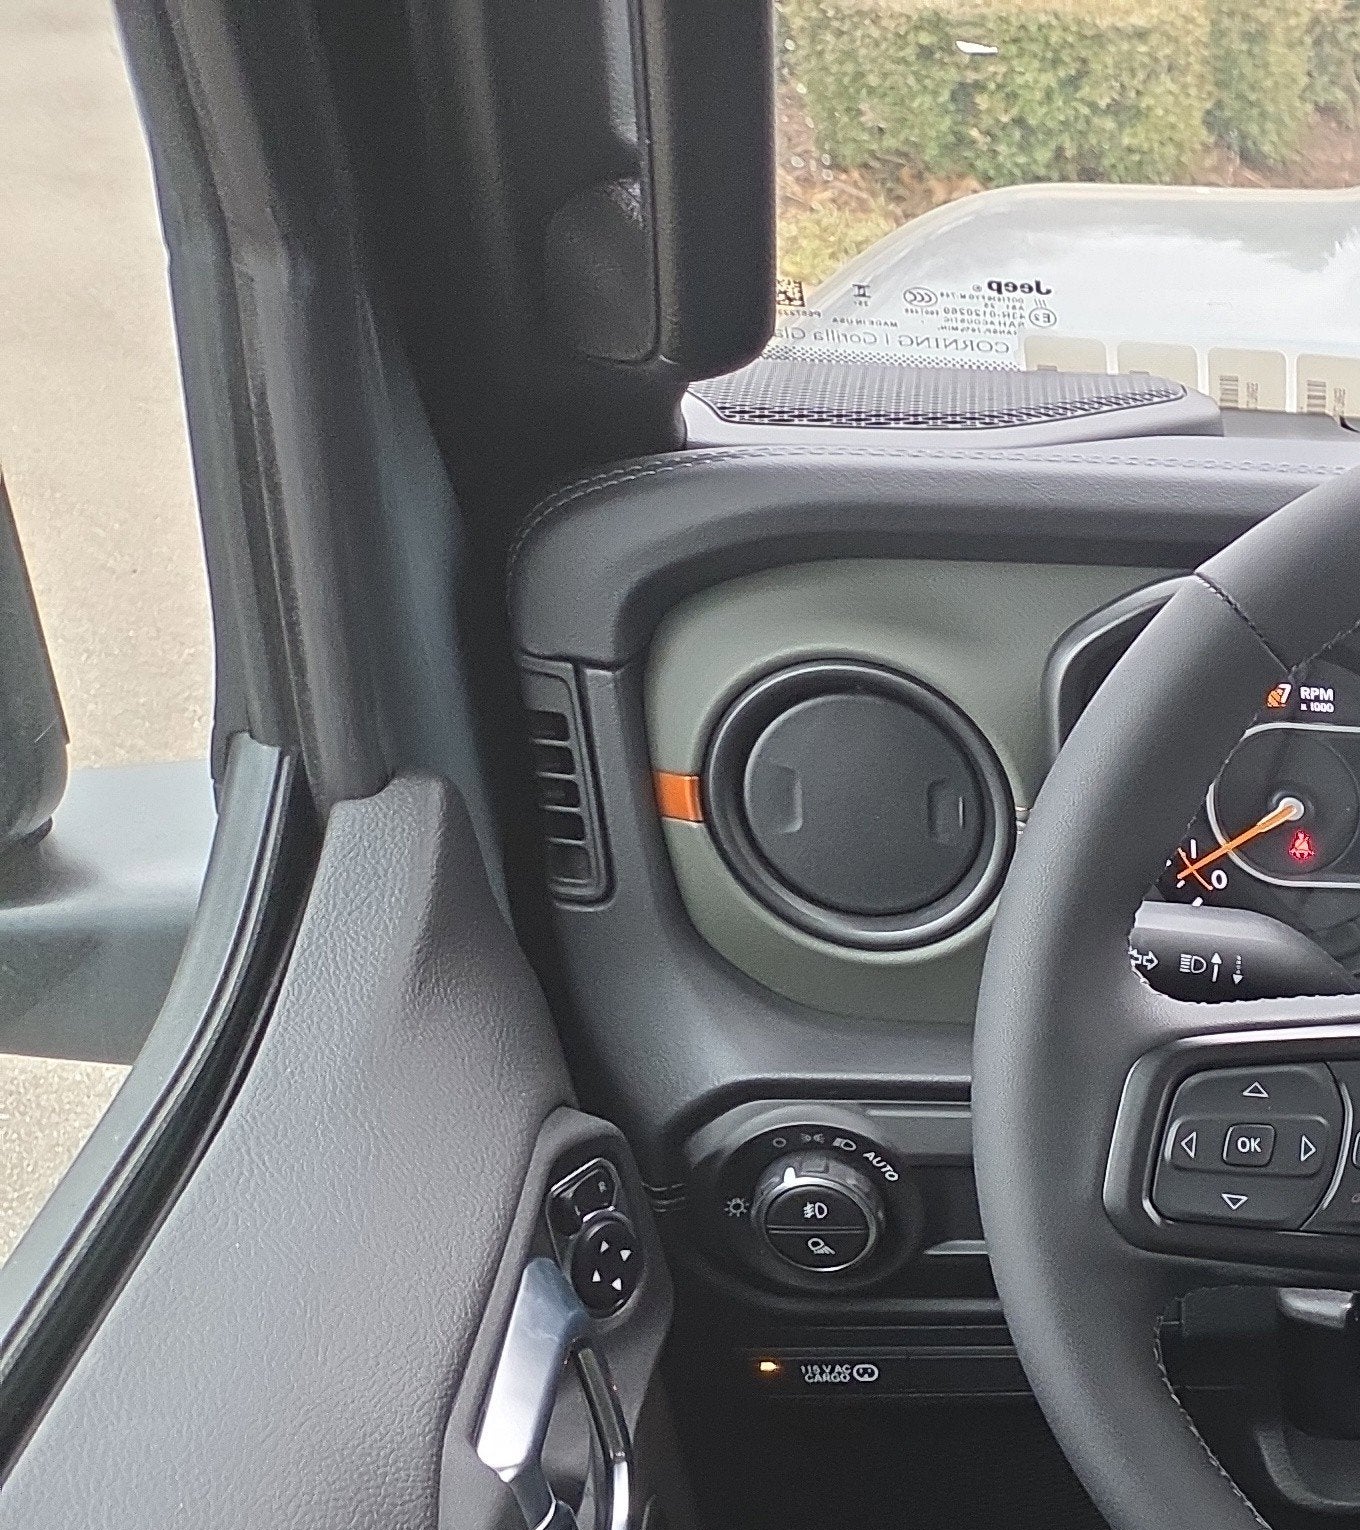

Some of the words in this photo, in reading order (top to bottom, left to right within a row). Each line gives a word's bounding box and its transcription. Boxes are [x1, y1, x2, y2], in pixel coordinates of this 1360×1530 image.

[1300, 686, 1334, 701] RPM
[1310, 702, 1334, 713] 1000
[1211, 869, 1228, 889] 0
[1237, 1137, 1262, 1153] OK
[863, 1151, 899, 1182] AUTO
[804, 1372, 850, 1383] CARGO
